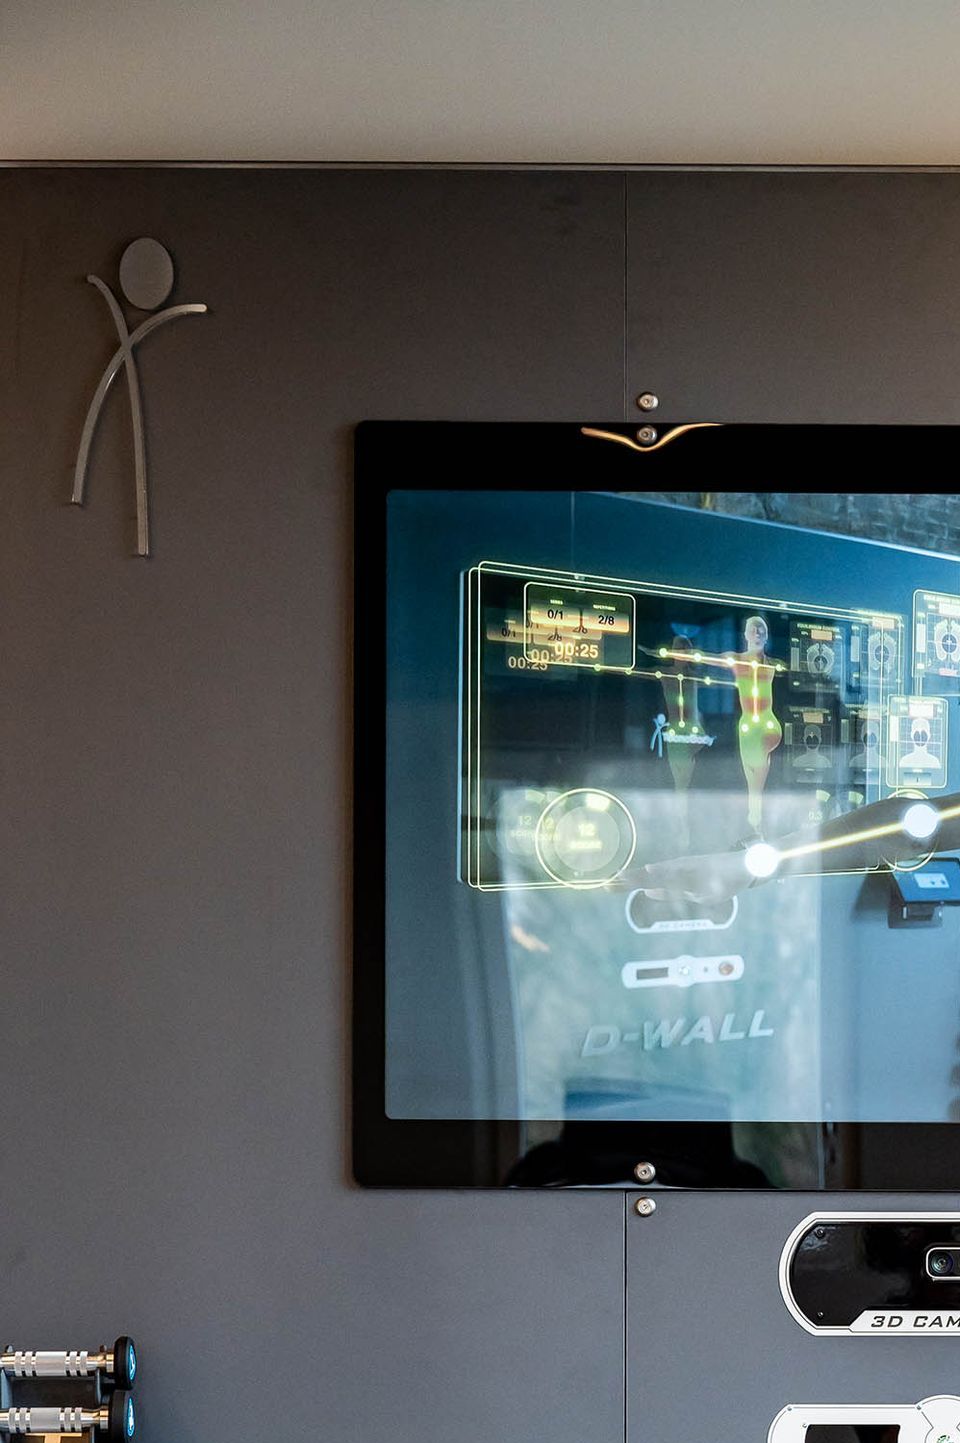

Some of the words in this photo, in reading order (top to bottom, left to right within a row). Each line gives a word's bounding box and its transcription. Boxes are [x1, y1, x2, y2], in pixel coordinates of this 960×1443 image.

[547, 609, 563, 620] 0/1
[598, 614, 615, 626] 2/8
[554, 641, 598, 658] 00:25
[581, 1009, 774, 1057] D-WALL
[870, 1314, 904, 1328] 3D
